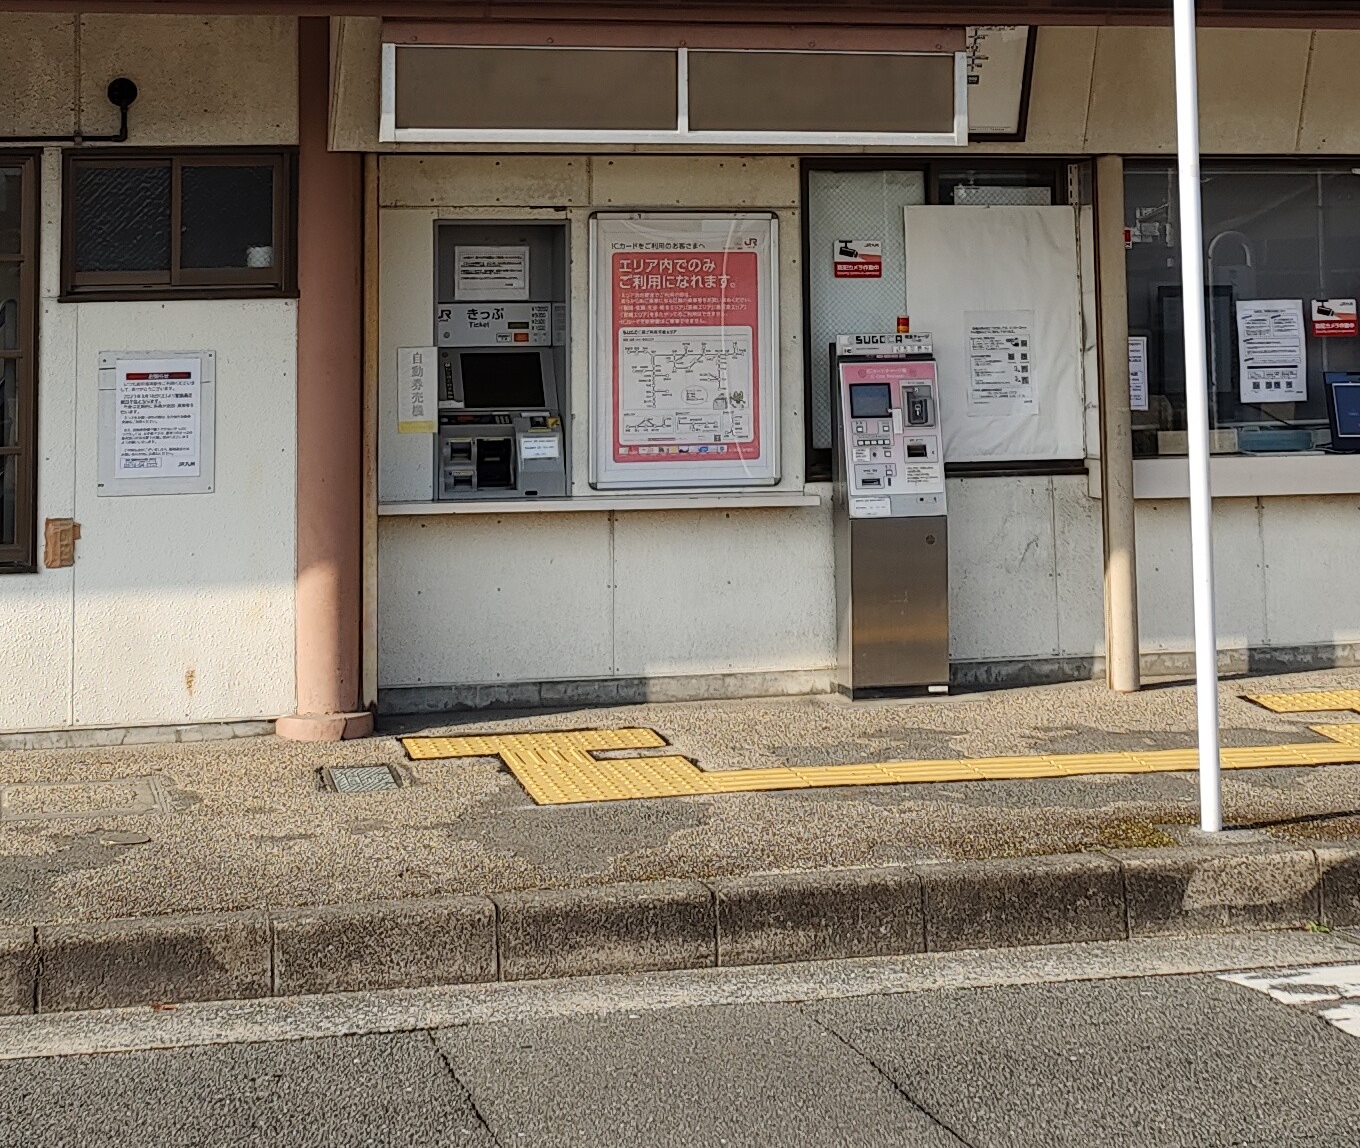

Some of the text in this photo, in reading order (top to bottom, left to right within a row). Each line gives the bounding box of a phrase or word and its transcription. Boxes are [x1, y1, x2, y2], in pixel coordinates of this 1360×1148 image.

[611, 242, 706, 250] ICカードをご利用のお客さまへ
[618, 258, 716, 273] エリア内でのみ
[618, 274, 736, 290] ご利用になれます。
[437, 309, 453, 320] JR
[466, 307, 505, 321] きっぷ
[411, 351, 425, 417] 自動券売機
